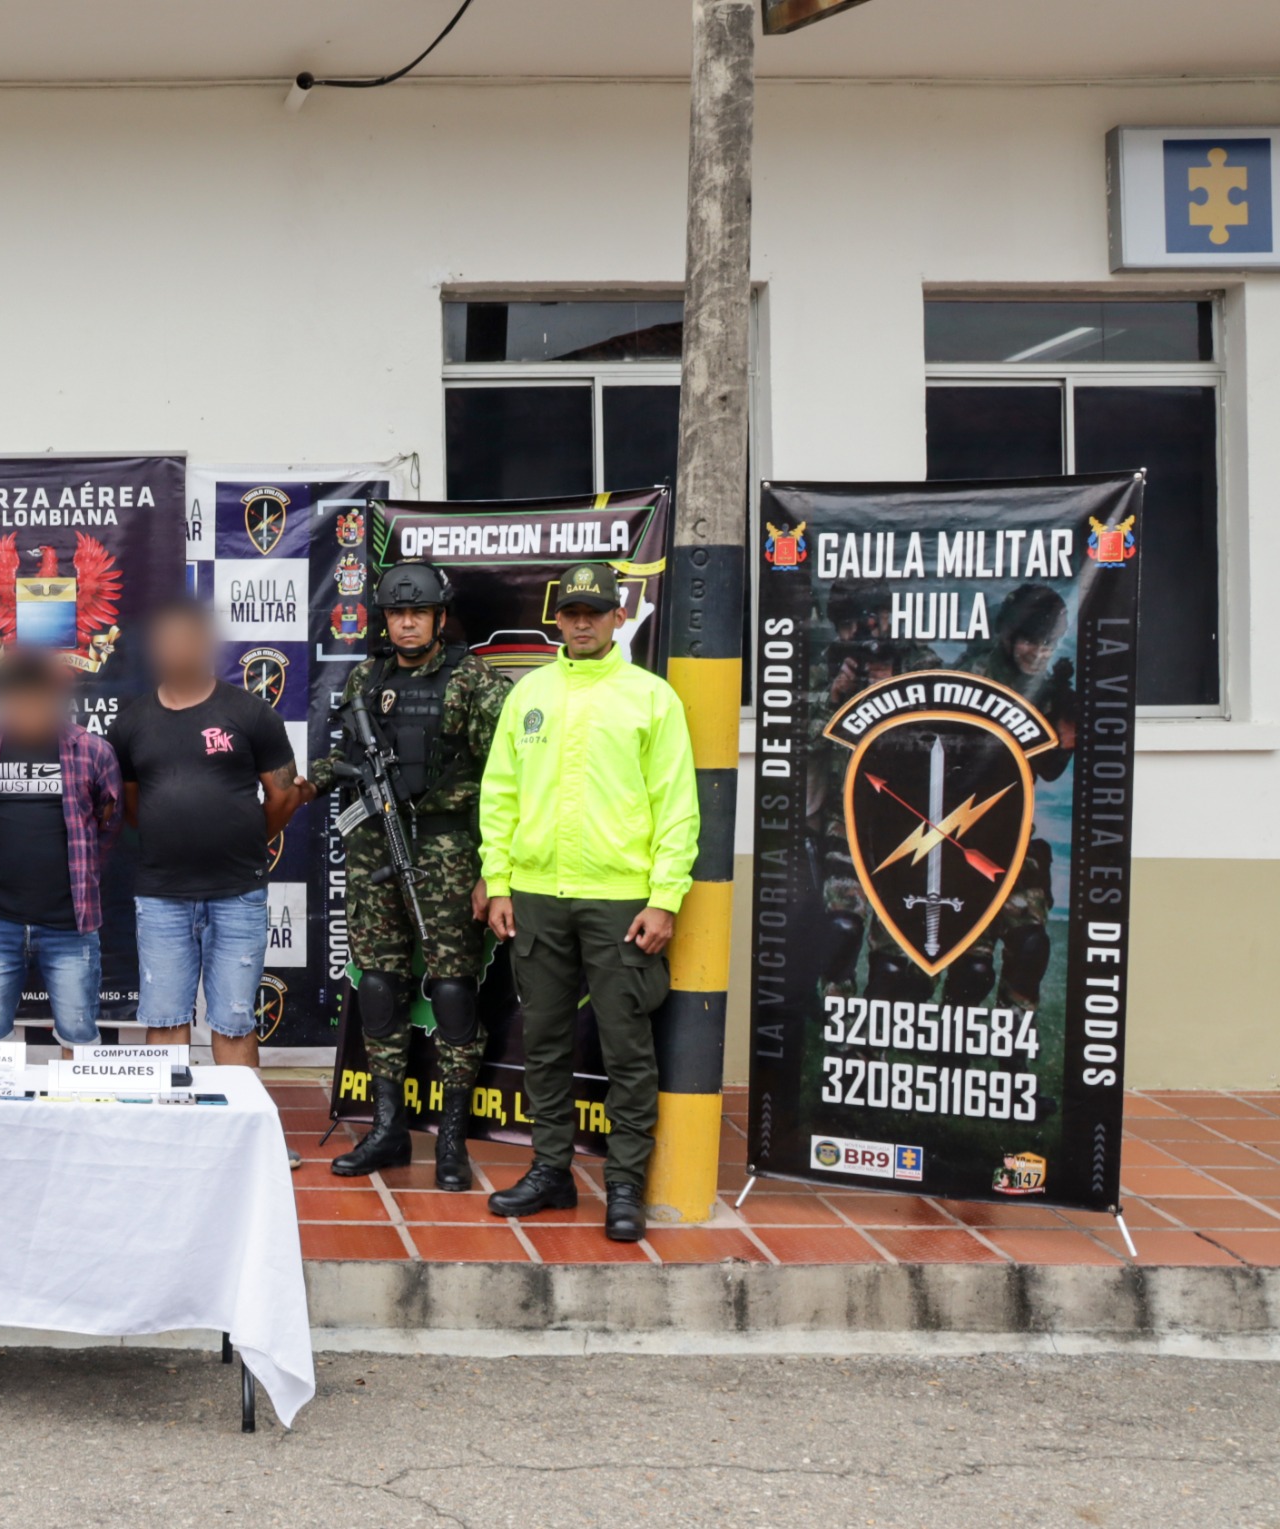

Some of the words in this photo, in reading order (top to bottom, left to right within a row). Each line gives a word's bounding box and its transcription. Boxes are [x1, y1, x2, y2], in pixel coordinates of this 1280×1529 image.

[59, 481, 155, 508] AÉREA
[401, 523, 542, 557] OPERACION
[549, 520, 630, 555] HUILA
[817, 531, 925, 580] GAULA
[936, 528, 1074, 578] MILITAR
[230, 579, 297, 602] GAULA
[566, 583, 600, 594] GAULA
[230, 602, 296, 623] MILITAR
[890, 591, 991, 640] HUILA
[1095, 617, 1130, 657] LA
[764, 617, 794, 727] TODOS
[83, 697, 119, 713] LAS
[841, 682, 926, 736] GAULA
[933, 682, 1041, 744] MILITAR
[761, 737, 792, 778] DE
[1091, 674, 1129, 848] VICTORIA
[36, 780, 60, 793] DO
[761, 793, 790, 832] ES
[1089, 865, 1123, 905] ES
[757, 848, 789, 1009] VICTORIA
[1086, 921, 1122, 964] DE
[756, 1024, 785, 1059] LA
[823, 995, 1039, 1059] 3208511584
[1082, 975, 1119, 1087] TODOS
[72, 1064, 155, 1076] CELULARES
[93, 1049, 169, 1058] COMPUTADOR
[822, 1056, 1038, 1121] 3208511693
[844, 1148, 890, 1168] BR9
[1015, 1172, 1042, 1188] 147
